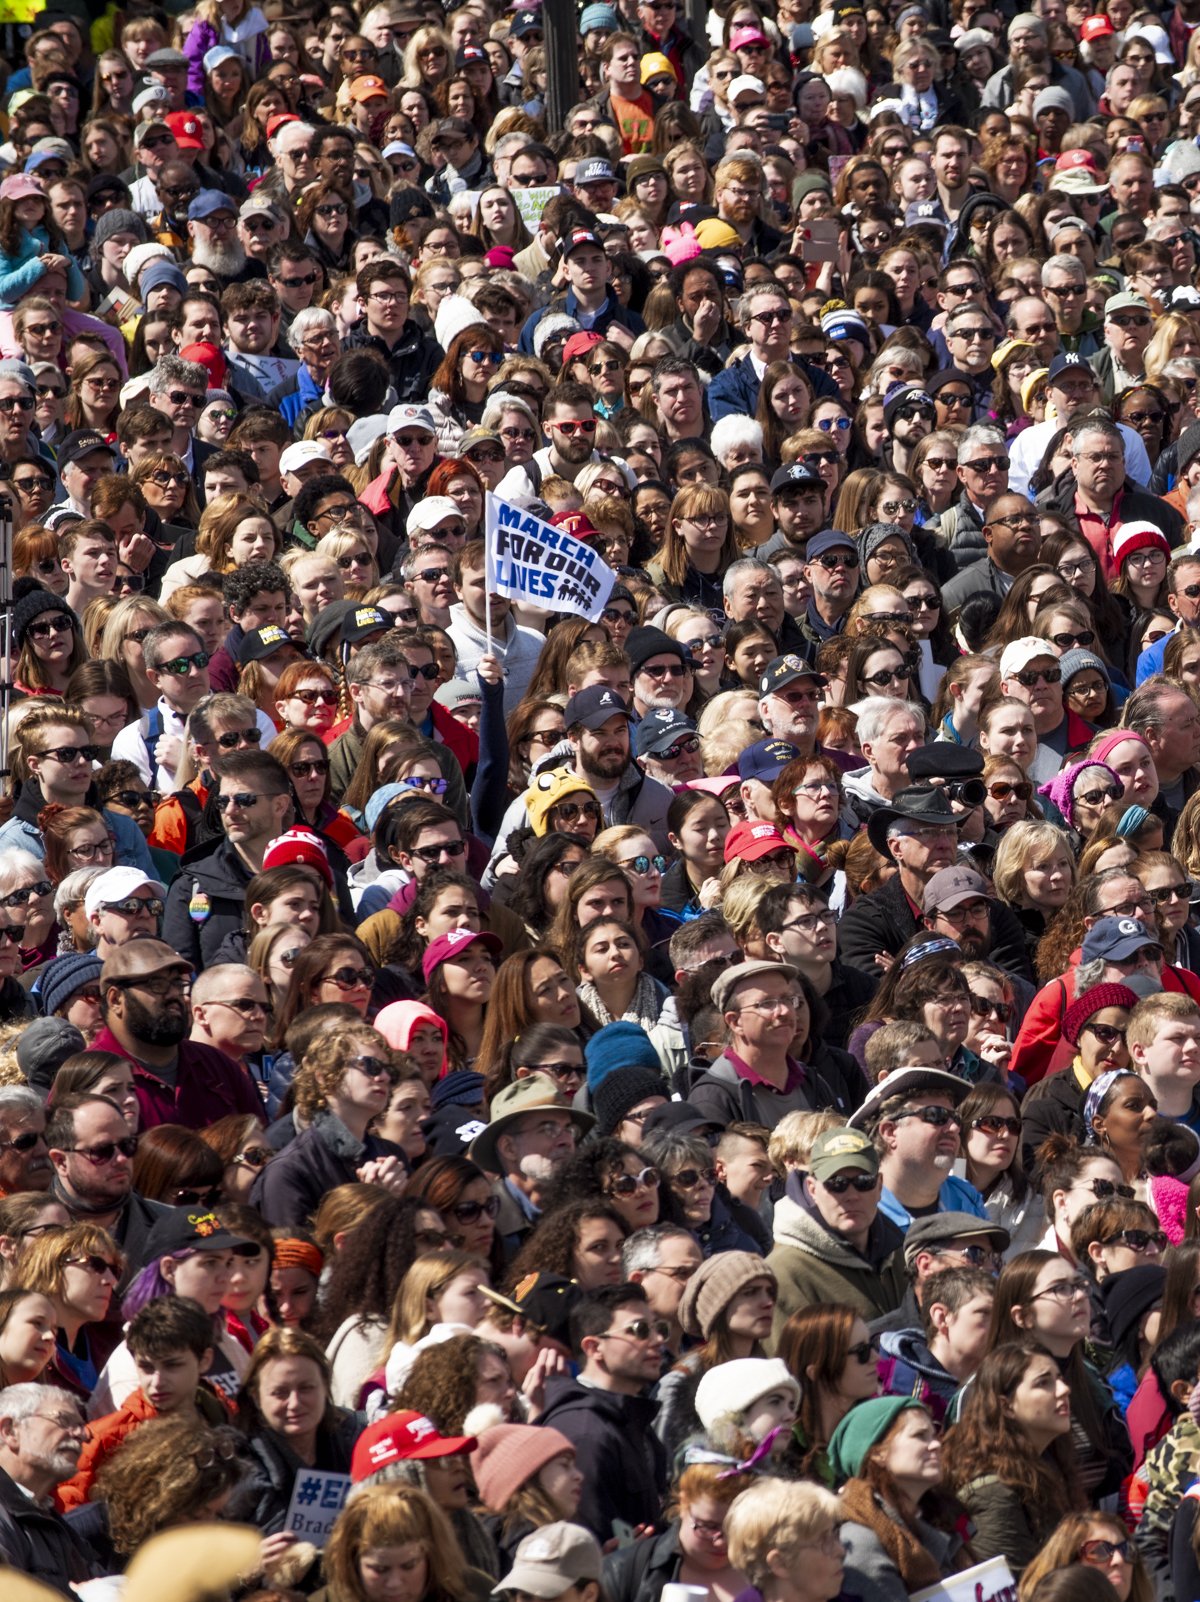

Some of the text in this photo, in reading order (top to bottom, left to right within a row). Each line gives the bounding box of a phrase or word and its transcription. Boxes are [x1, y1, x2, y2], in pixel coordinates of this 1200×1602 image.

[1065, 352, 1080, 364] NY
[499, 503, 596, 569] MARCH
[495, 560, 560, 599] LIVES
[497, 529, 602, 597] FOR OUR
[775, 663, 788, 677] NY
[297, 1477, 352, 1511] #E
